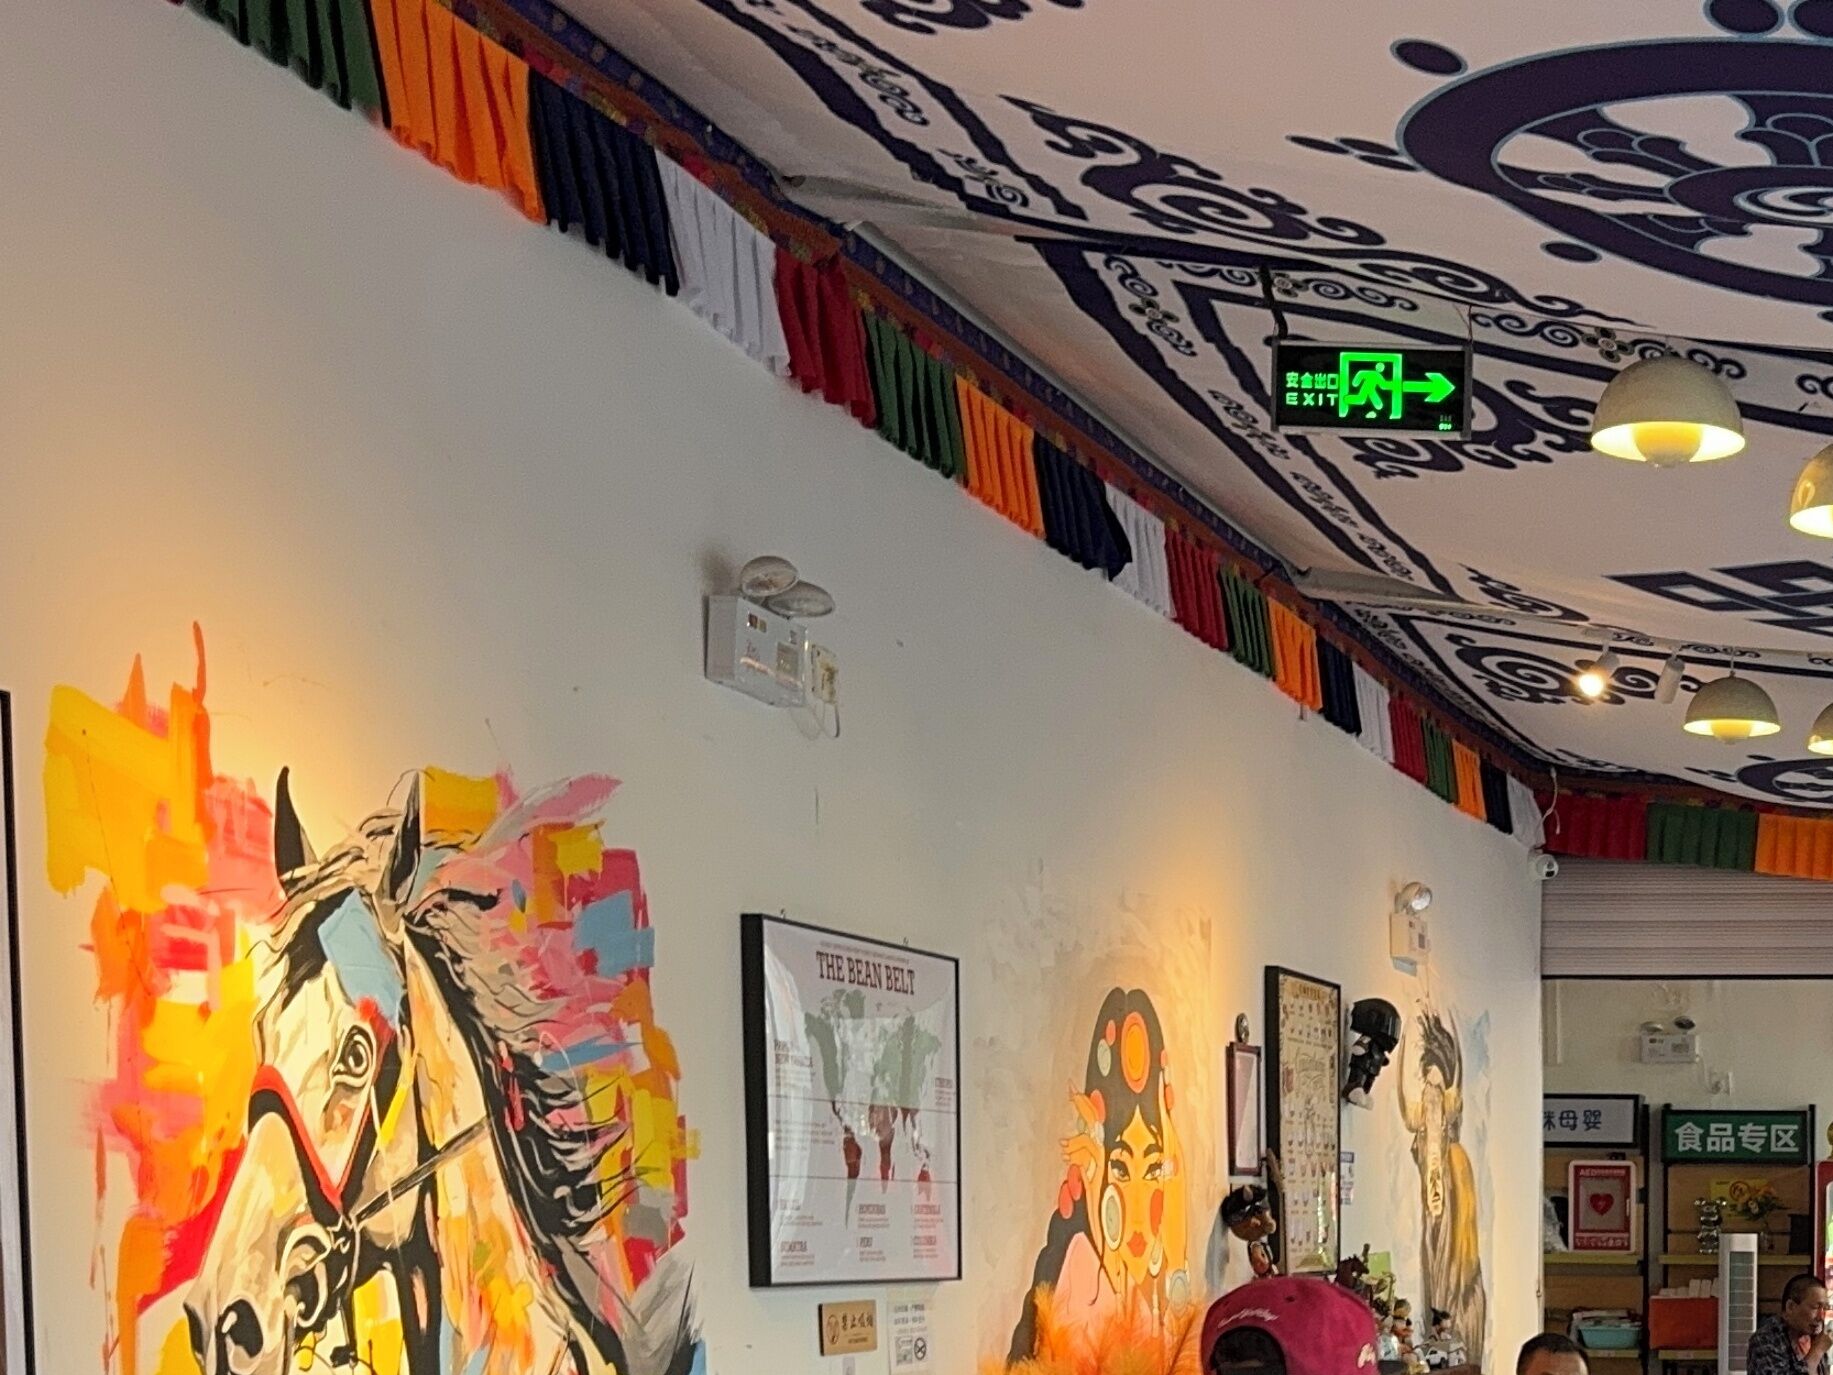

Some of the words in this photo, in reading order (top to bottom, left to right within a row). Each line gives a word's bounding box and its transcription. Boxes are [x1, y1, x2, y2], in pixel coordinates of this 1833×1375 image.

[1285, 372, 1339, 390] 安全出口
[1285, 392, 1339, 406] EXIT
[816, 950, 845, 982] THE
[847, 957, 883, 990] BEAN
[884, 964, 916, 996] BELT
[1674, 1121, 1799, 1153] 食品专区
